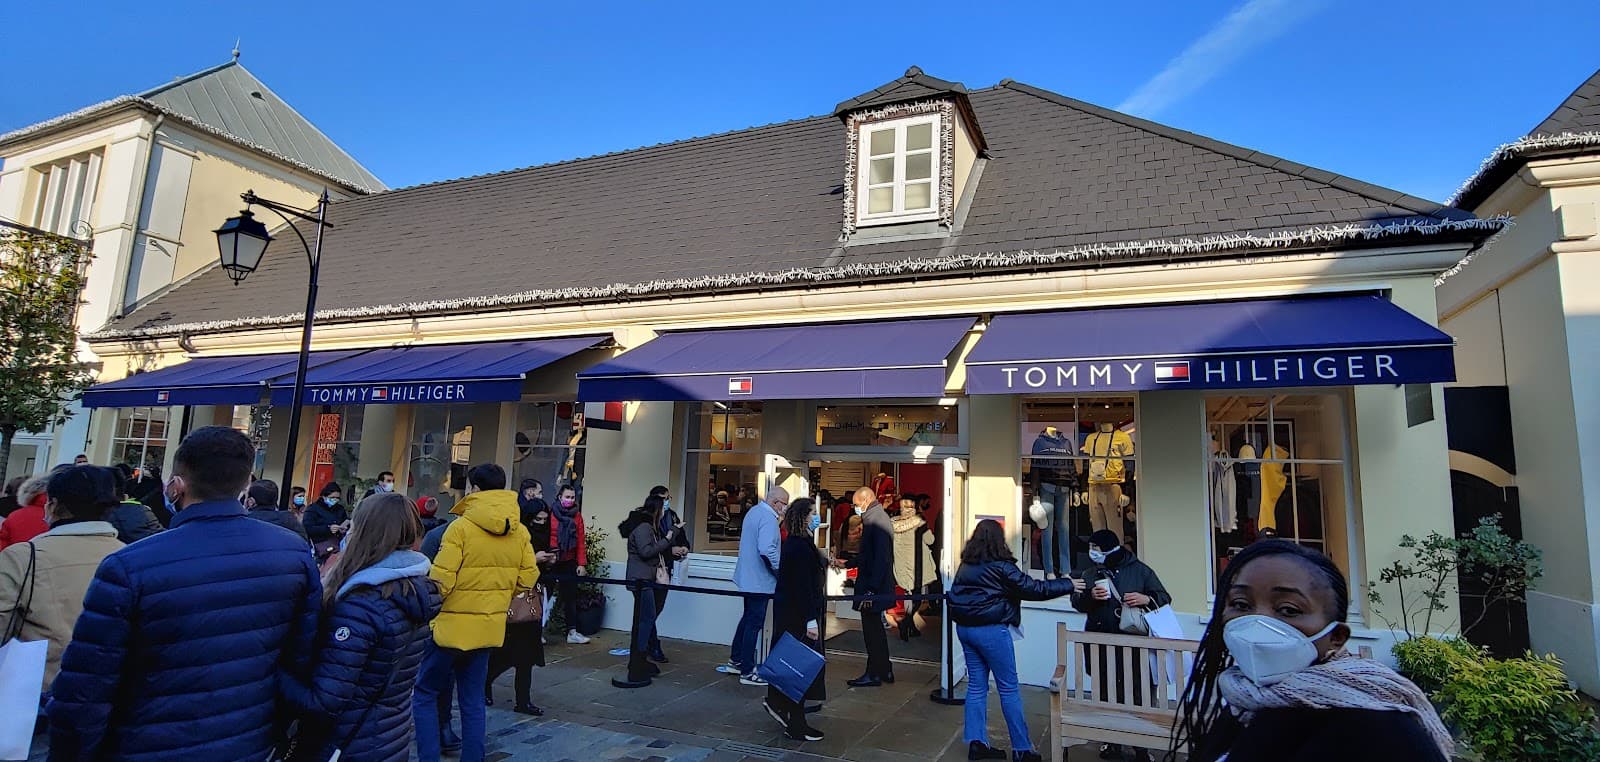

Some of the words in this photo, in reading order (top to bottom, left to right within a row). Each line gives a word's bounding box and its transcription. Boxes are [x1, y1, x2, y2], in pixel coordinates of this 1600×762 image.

[1001, 363, 1143, 388] TOMMY
[1204, 354, 1399, 382] HILFIGER
[311, 387, 369, 402] TOMMY
[391, 384, 465, 401] HILFIGER
